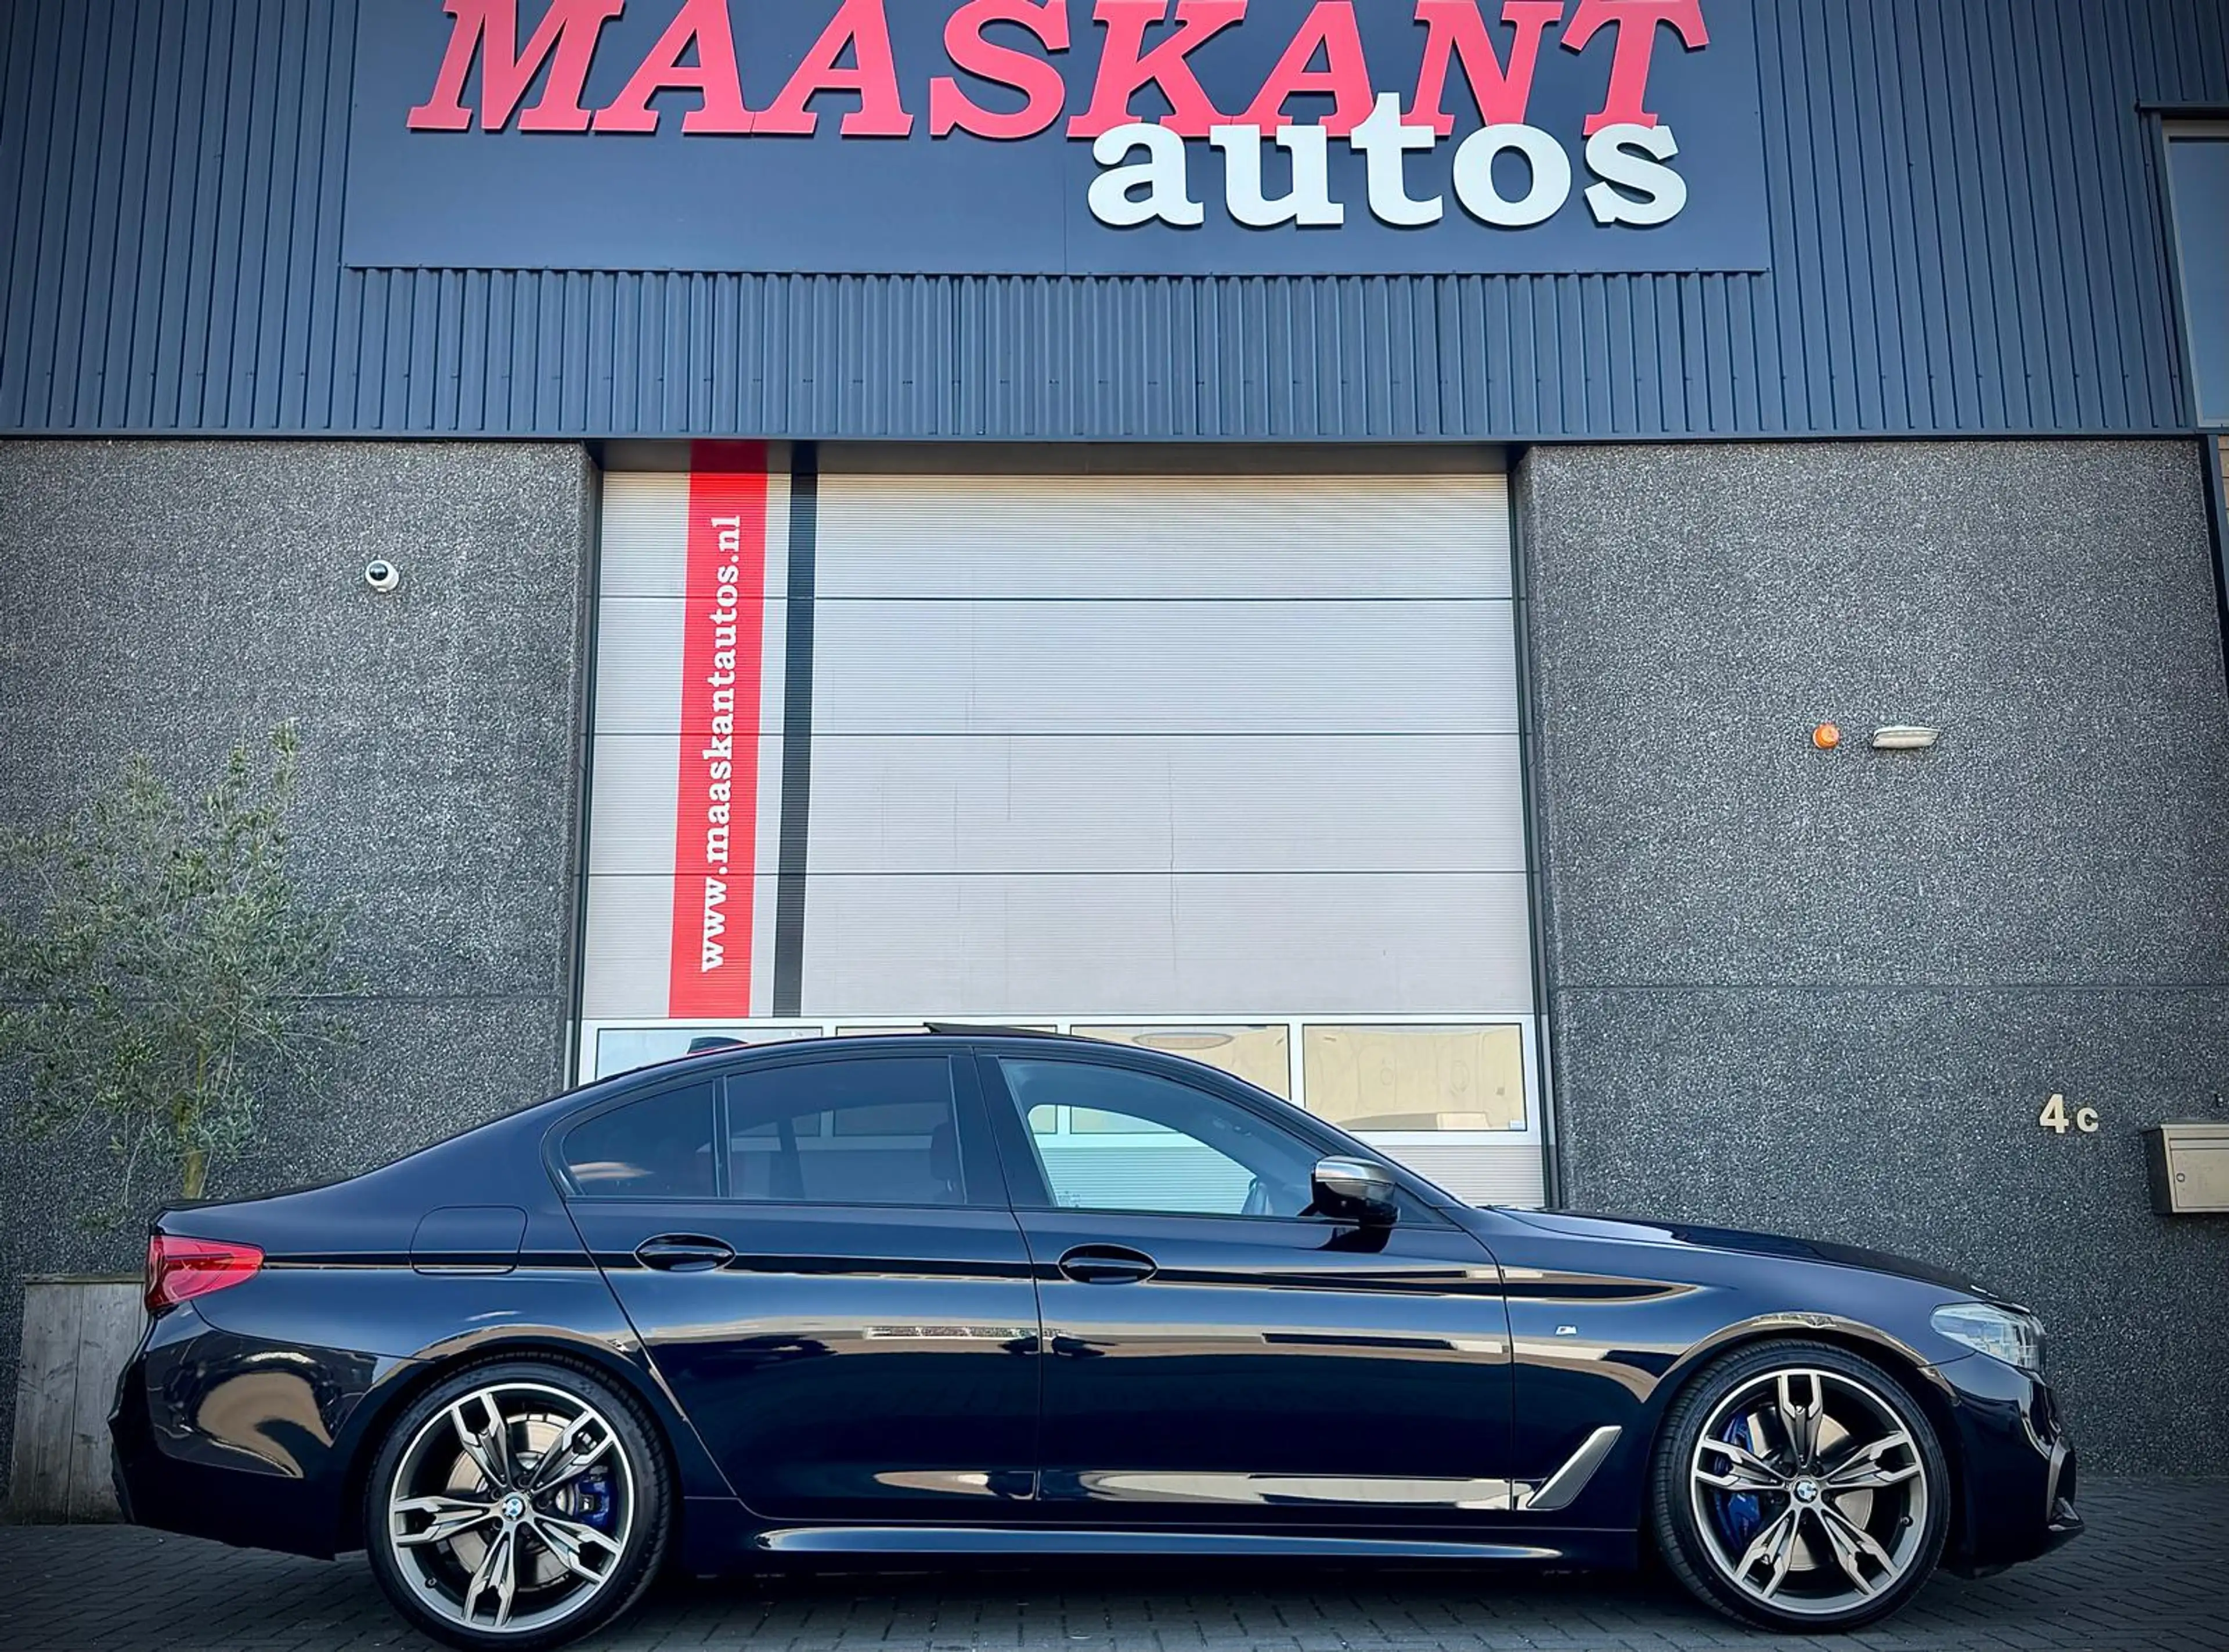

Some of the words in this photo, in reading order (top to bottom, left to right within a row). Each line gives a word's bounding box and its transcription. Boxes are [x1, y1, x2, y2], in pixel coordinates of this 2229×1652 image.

[409, 0, 1708, 140] MAASKANT
[1087, 93, 1687, 229] autos
[701, 515, 742, 973] www.maaskantautos.nl
